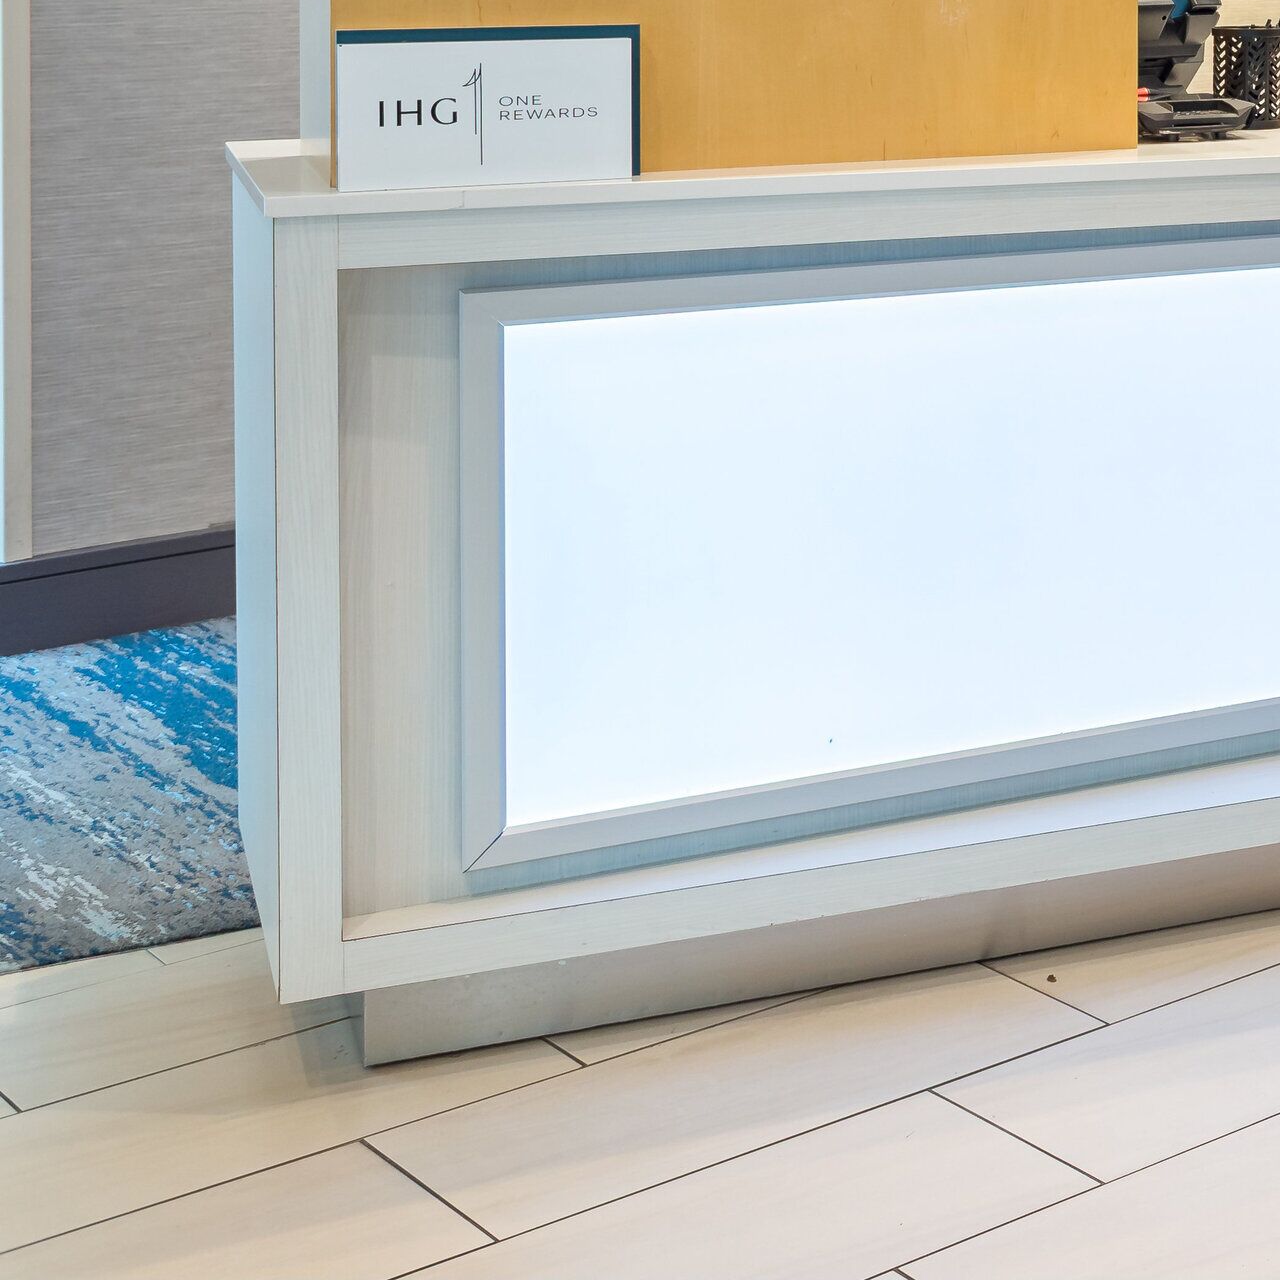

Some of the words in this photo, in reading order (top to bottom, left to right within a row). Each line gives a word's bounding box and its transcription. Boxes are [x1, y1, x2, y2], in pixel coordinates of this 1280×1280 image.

[378, 96, 458, 128] IHG
[498, 94, 543, 107] ONE
[498, 106, 599, 121] REWARDS
